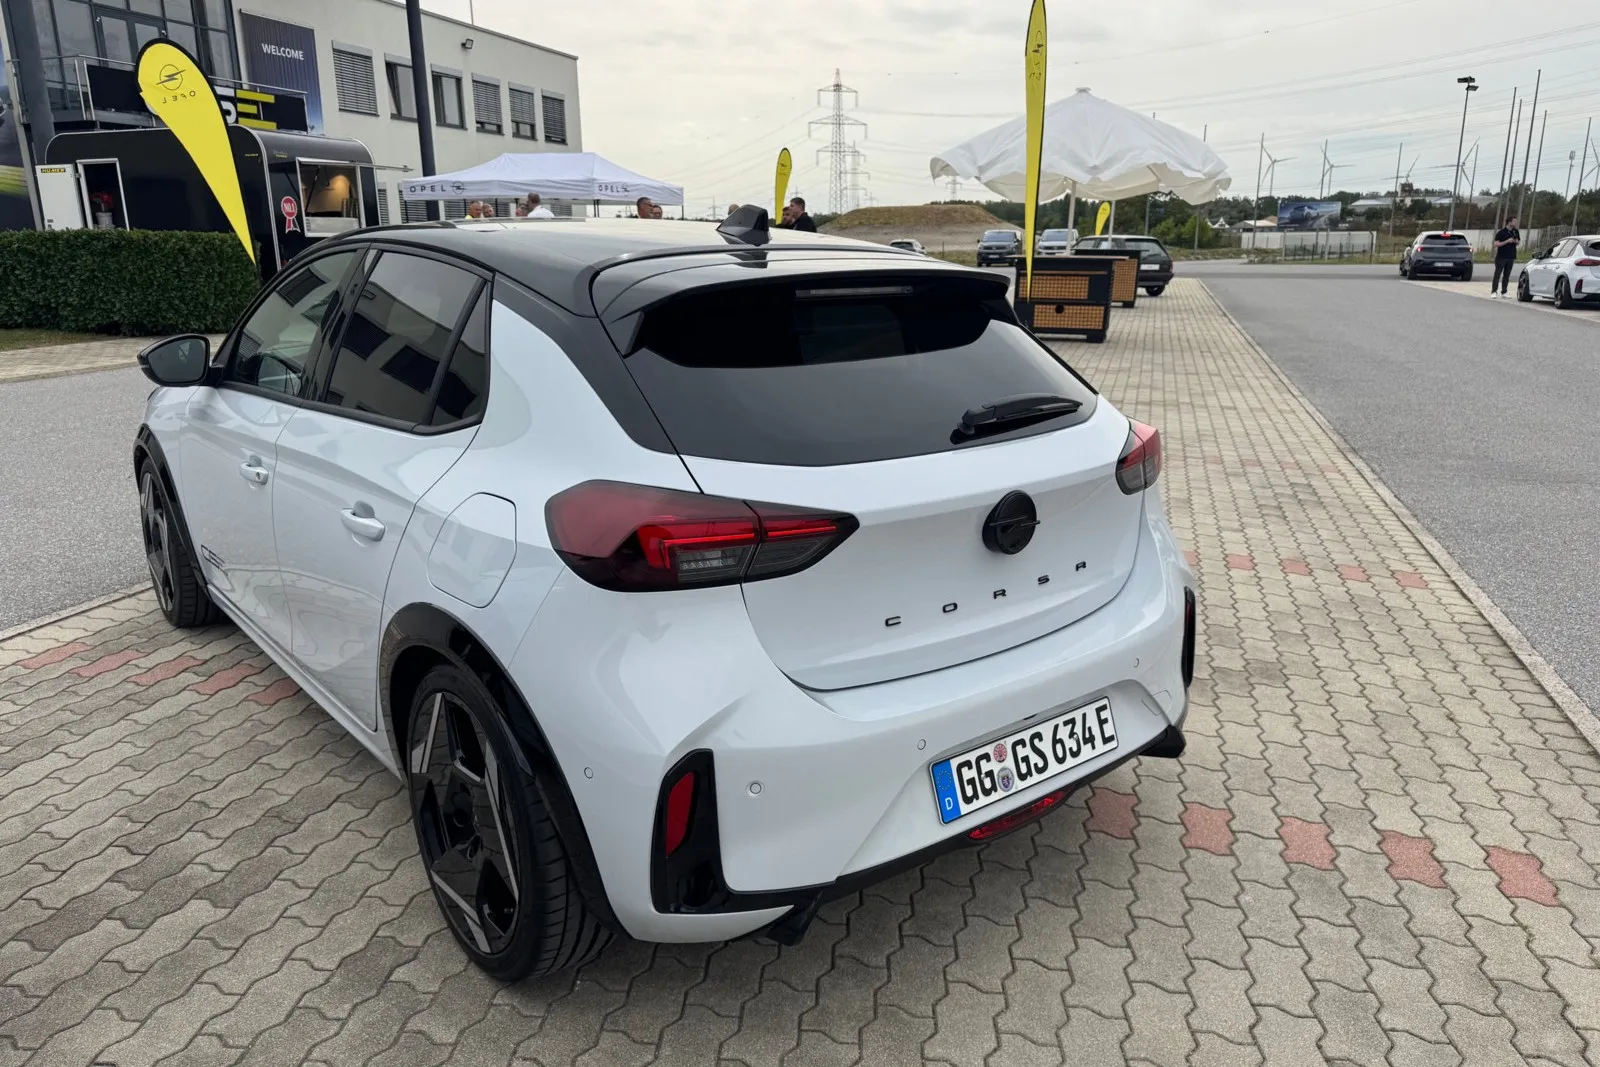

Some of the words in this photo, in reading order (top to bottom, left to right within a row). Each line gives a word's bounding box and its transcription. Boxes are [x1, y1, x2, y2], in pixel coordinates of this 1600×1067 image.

[261, 43, 304, 61] WELCOME
[409, 183, 447, 193] OPEL
[598, 184, 621, 193] OPEL
[884, 561, 1087, 627] CORSA
[956, 752, 998, 805] GG
[1012, 731, 1049, 781] GS
[945, 797, 954, 810] D
